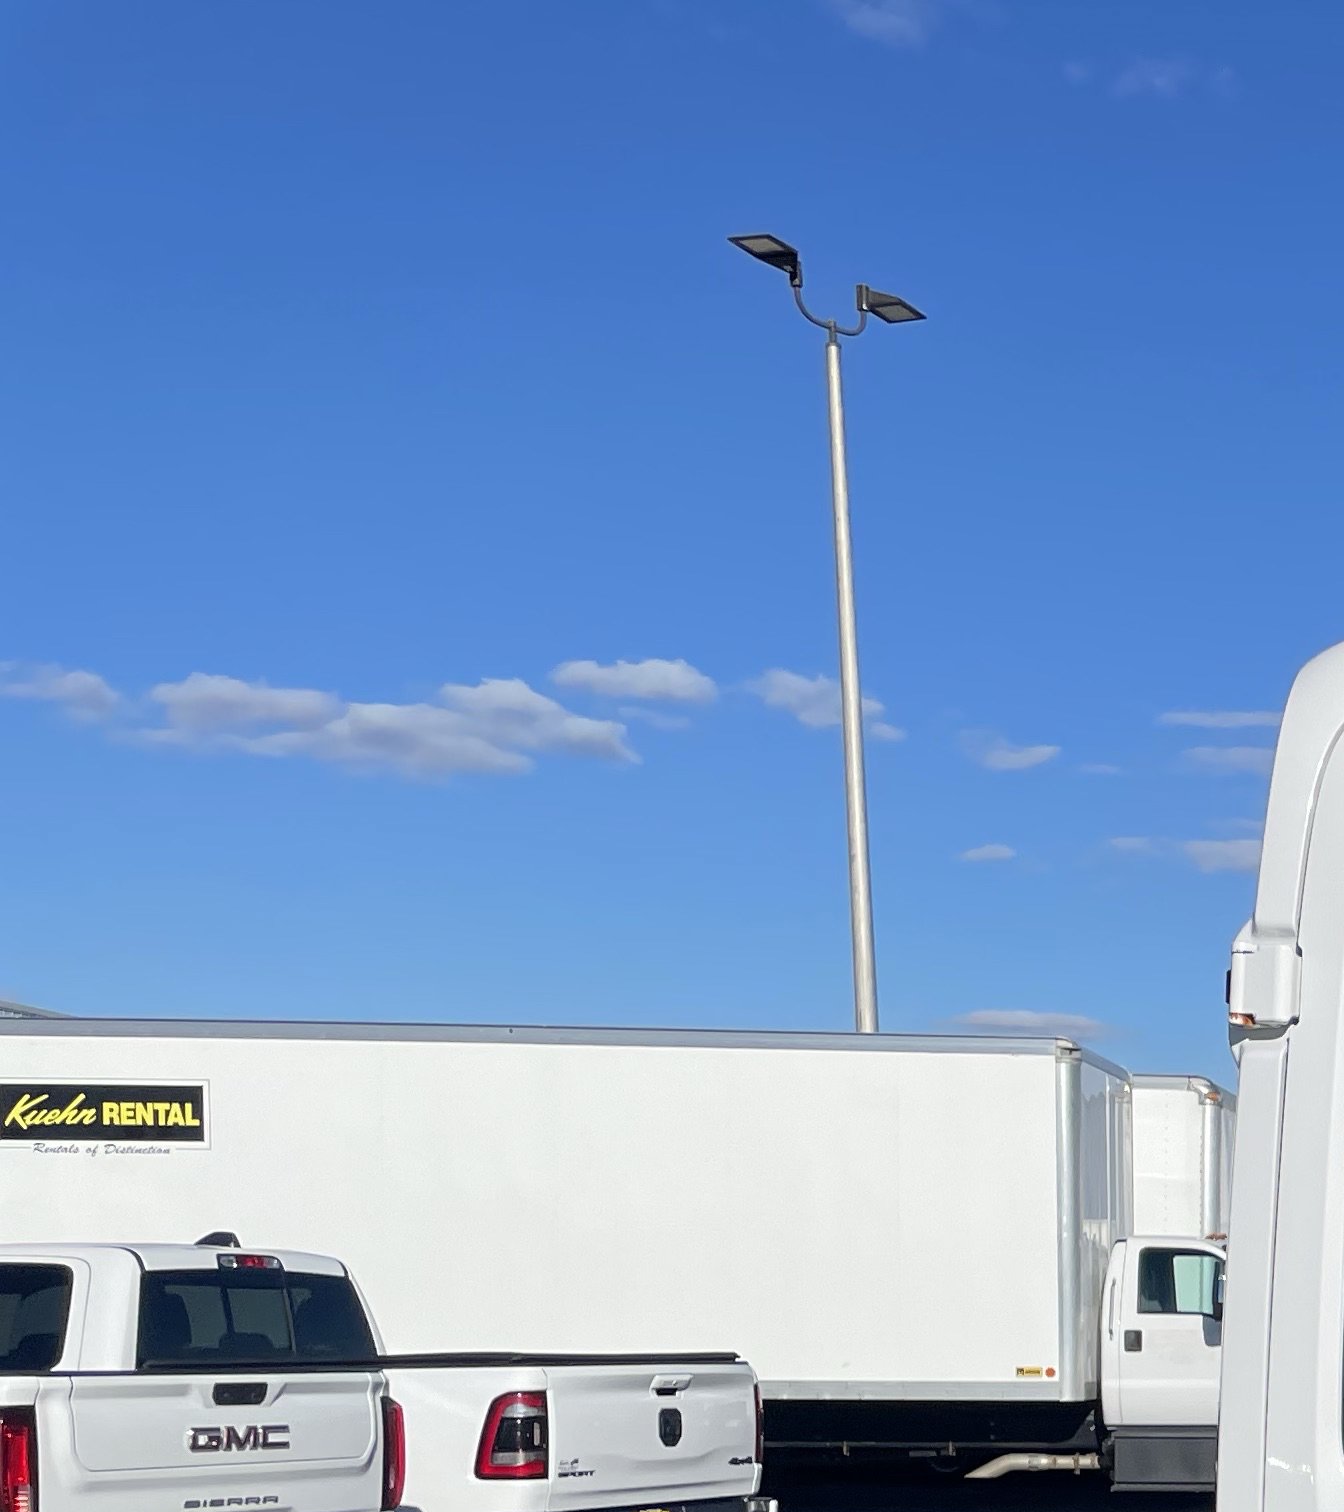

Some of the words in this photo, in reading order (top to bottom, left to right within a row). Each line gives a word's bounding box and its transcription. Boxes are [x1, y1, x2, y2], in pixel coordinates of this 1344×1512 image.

[4, 1092, 97, 1130] Kuehn
[102, 1101, 201, 1127] RENTAL
[32, 1142, 80, 1154] Rentals
[85, 1144, 100, 1157] of
[104, 1143, 171, 1155] Distinction
[190, 1424, 290, 1453] GMC
[183, 1495, 279, 1509] SIERRA
